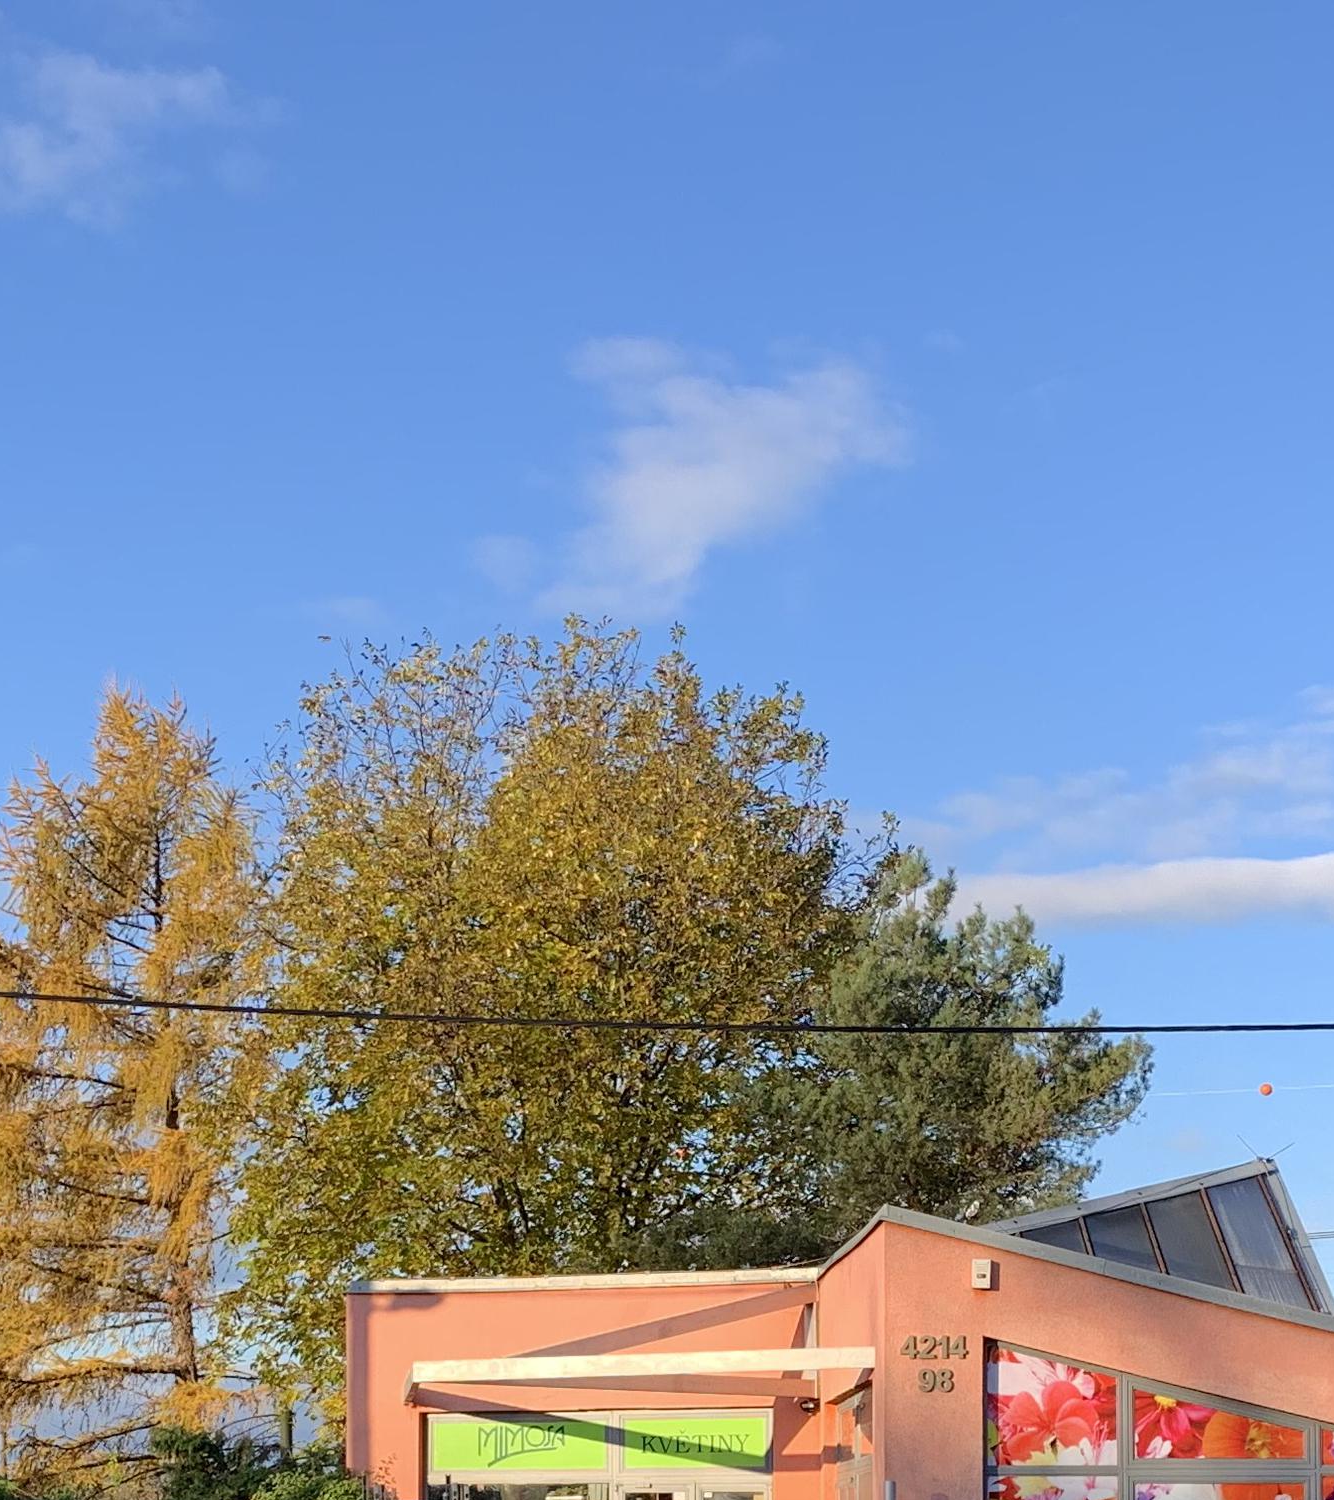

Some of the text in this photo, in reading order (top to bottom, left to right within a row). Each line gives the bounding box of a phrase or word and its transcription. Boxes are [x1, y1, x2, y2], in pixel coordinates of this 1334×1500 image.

[900, 1335, 969, 1360] 4214
[918, 1368, 954, 1393] 98
[478, 1424, 567, 1465] MIMOSA
[641, 1430, 752, 1454] KVĚTINY
